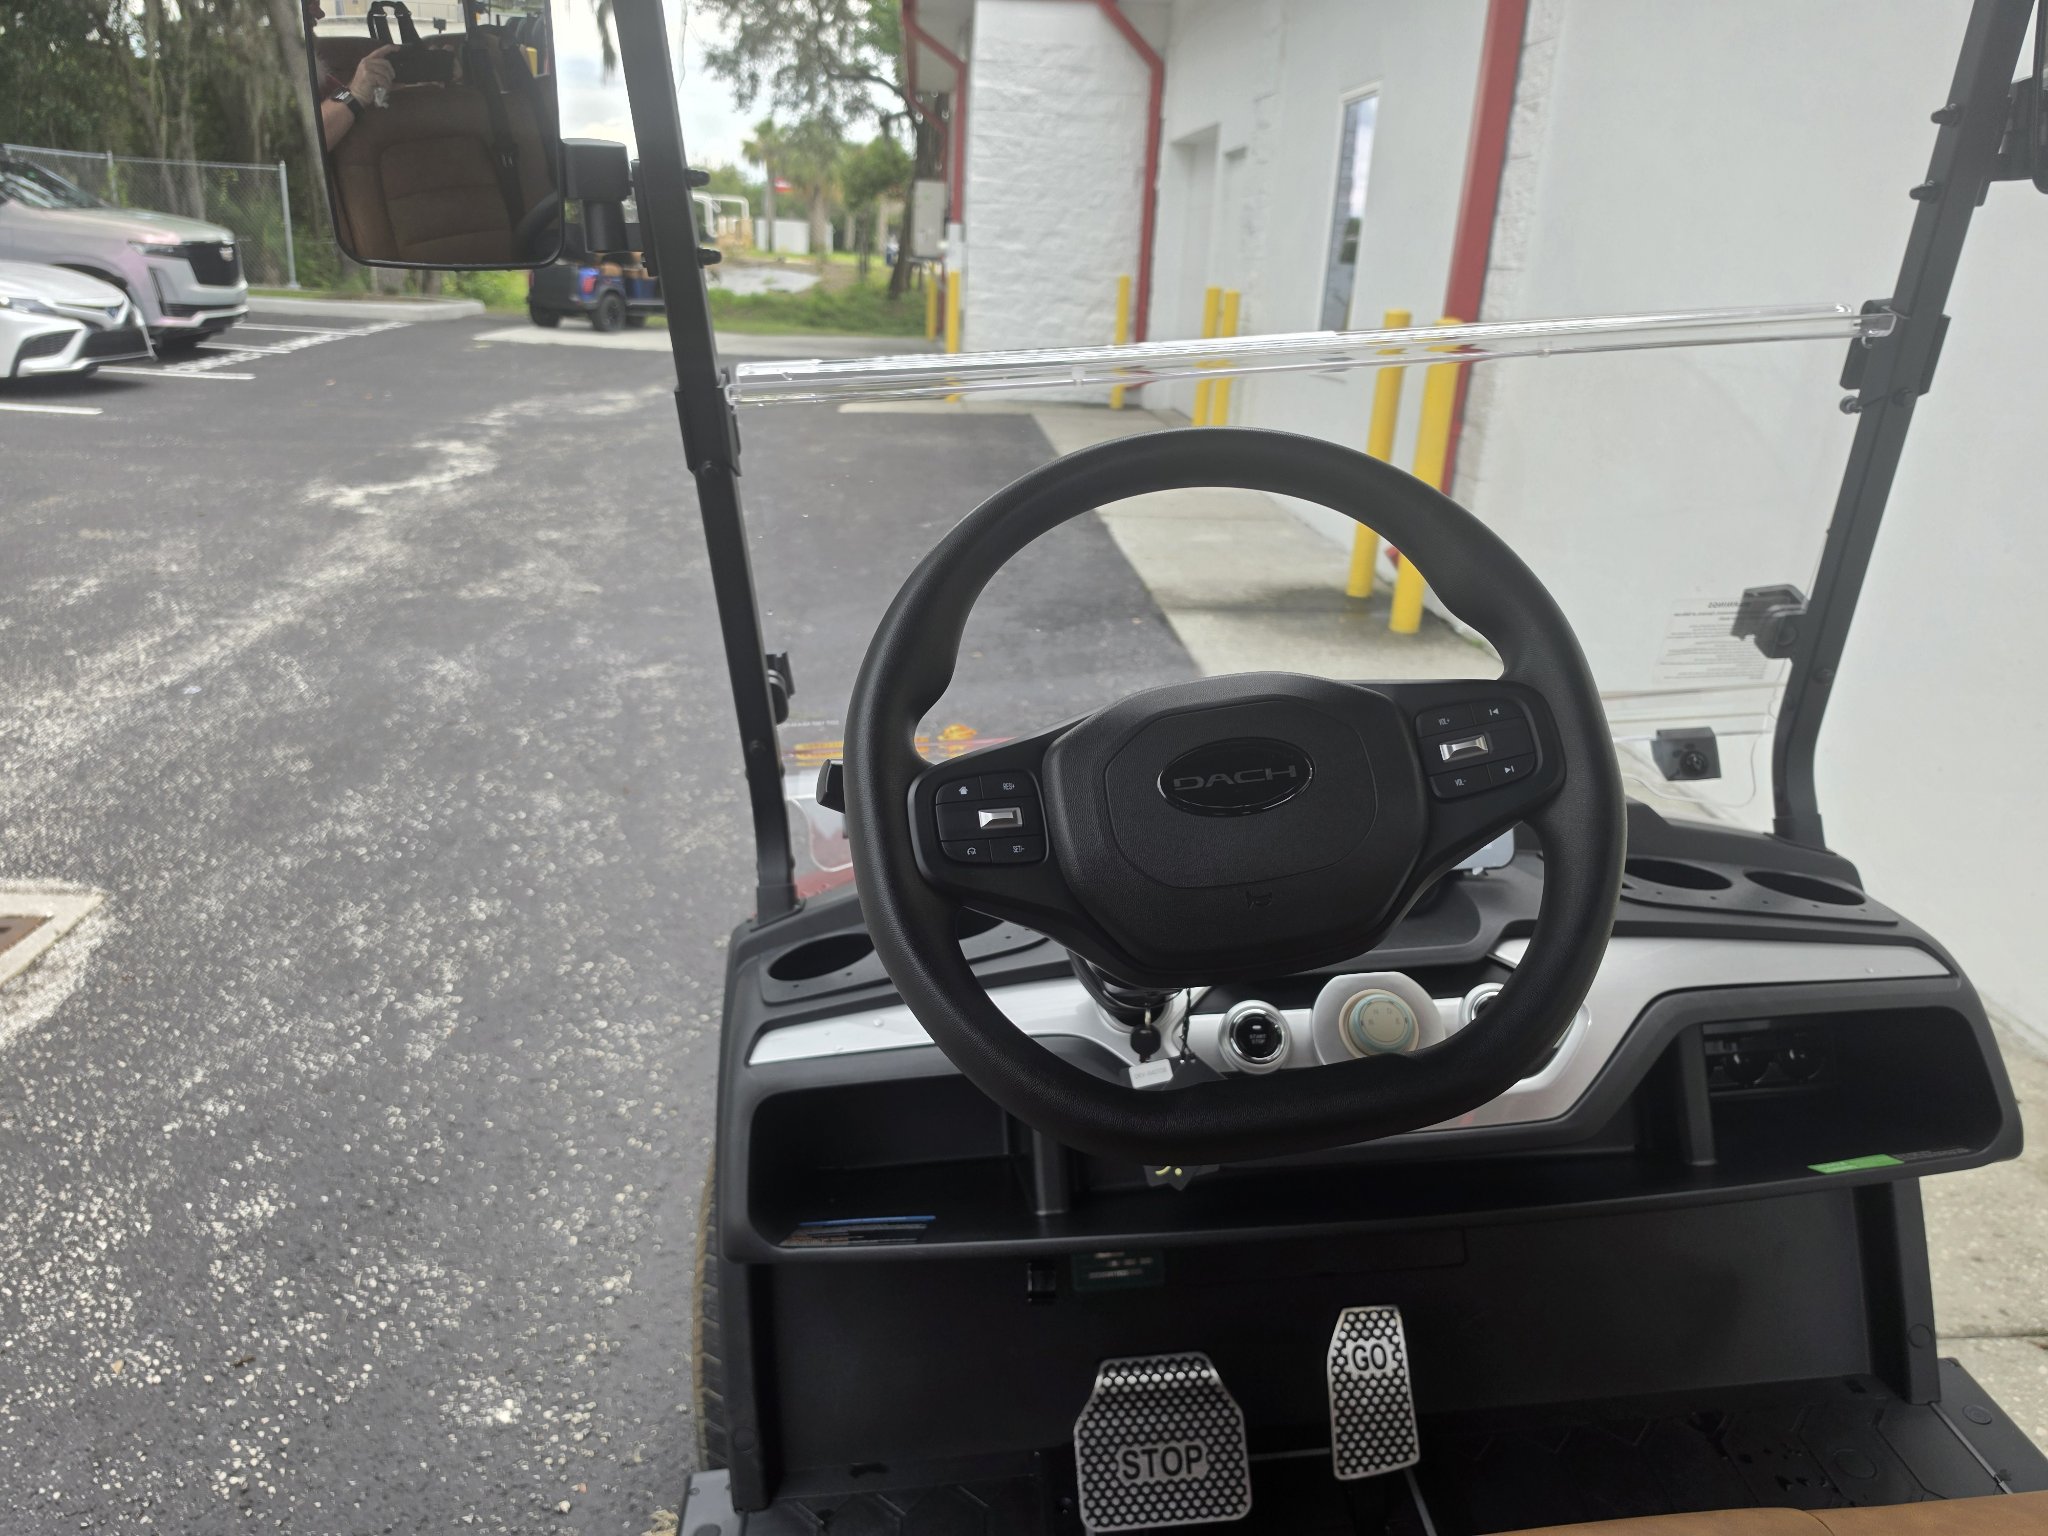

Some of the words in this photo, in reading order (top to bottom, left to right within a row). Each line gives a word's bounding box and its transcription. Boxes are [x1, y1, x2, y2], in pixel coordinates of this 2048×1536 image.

[1173, 765, 1297, 791] DACH
[1352, 1343, 1387, 1371] GO
[1122, 1444, 1203, 1480] STOP
